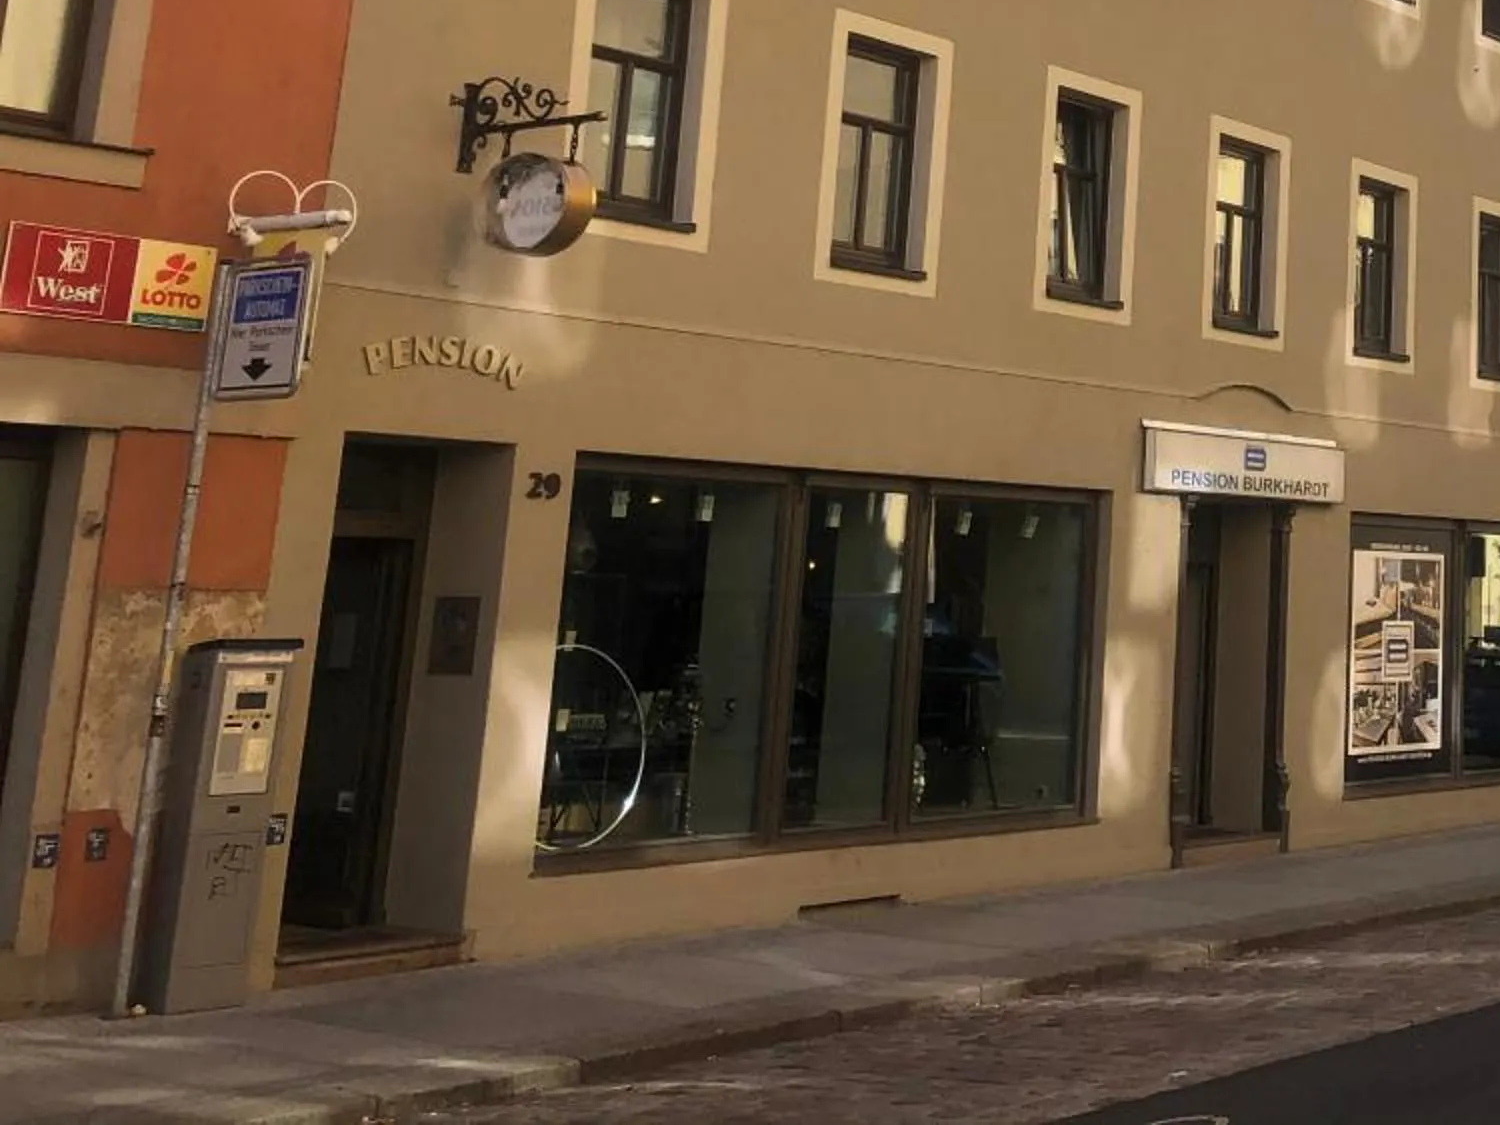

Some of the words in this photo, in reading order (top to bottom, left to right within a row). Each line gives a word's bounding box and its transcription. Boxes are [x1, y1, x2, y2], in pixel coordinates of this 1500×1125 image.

[36, 276, 101, 304] West
[141, 288, 201, 310] LOTTO
[363, 335, 526, 391] PENSION
[525, 472, 562, 500] 29
[1171, 469, 1239, 492] PENSION
[1243, 476, 1331, 499] BURKHARDT
